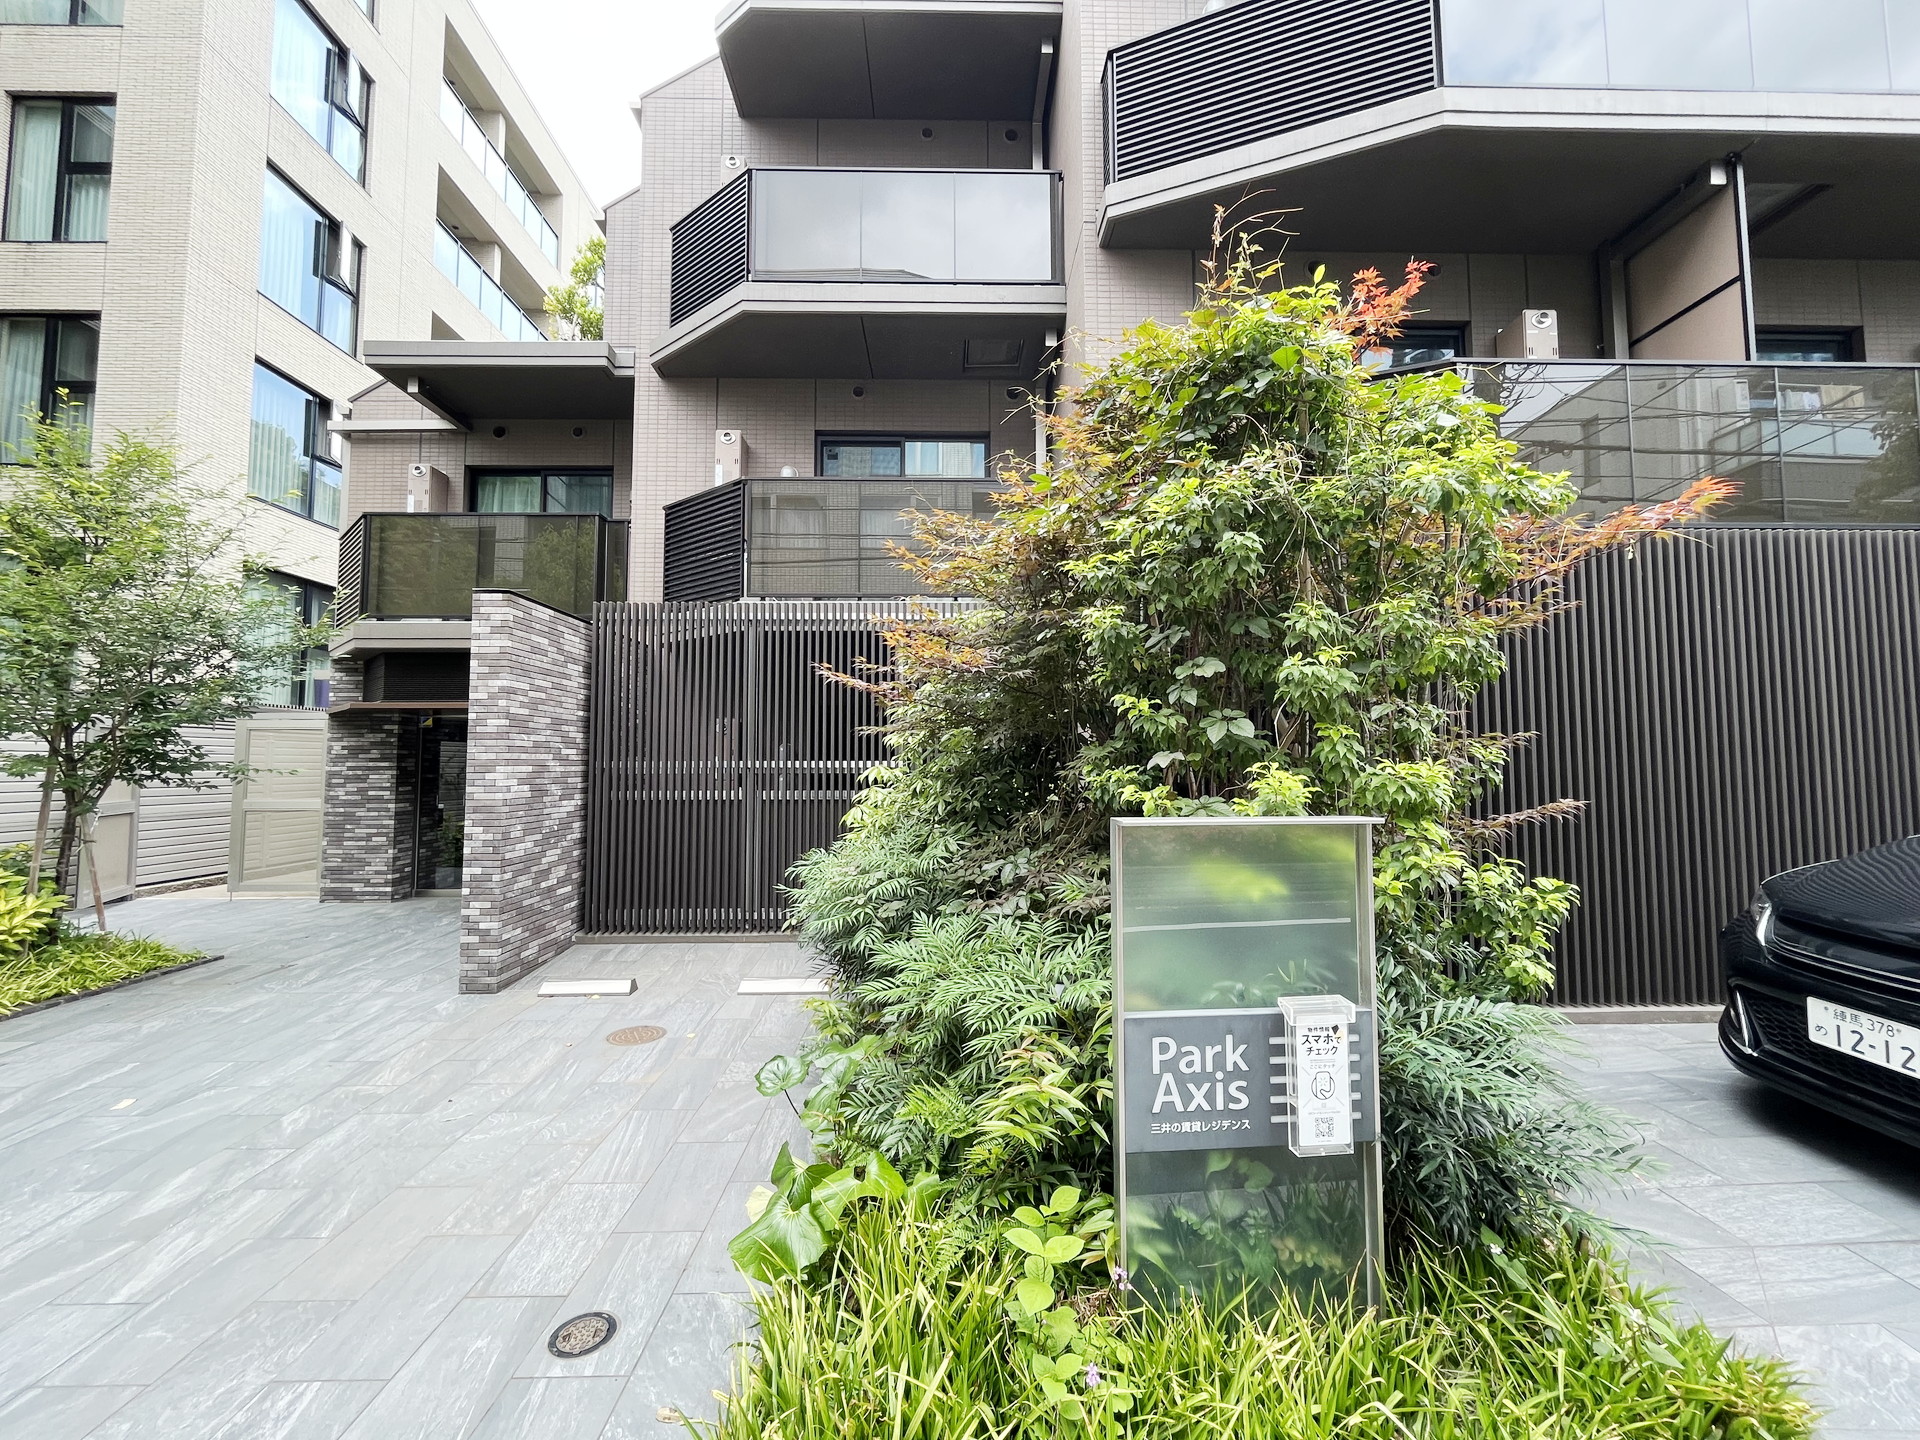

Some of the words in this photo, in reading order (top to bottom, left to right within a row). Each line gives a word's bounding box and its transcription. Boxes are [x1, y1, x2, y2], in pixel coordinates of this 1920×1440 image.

[1833, 1008, 1863, 1028] 練馬
[1866, 1018, 1895, 1038] 378
[1151, 1034, 1250, 1075] Park
[1301, 1033, 1342, 1046] スマホで
[1306, 1045, 1339, 1057] チェック
[1836, 1024, 1917, 1073] 12-12
[1151, 1070, 1250, 1114] Axis
[1150, 1119, 1251, 1134] 三井の賃貸レジデンス
